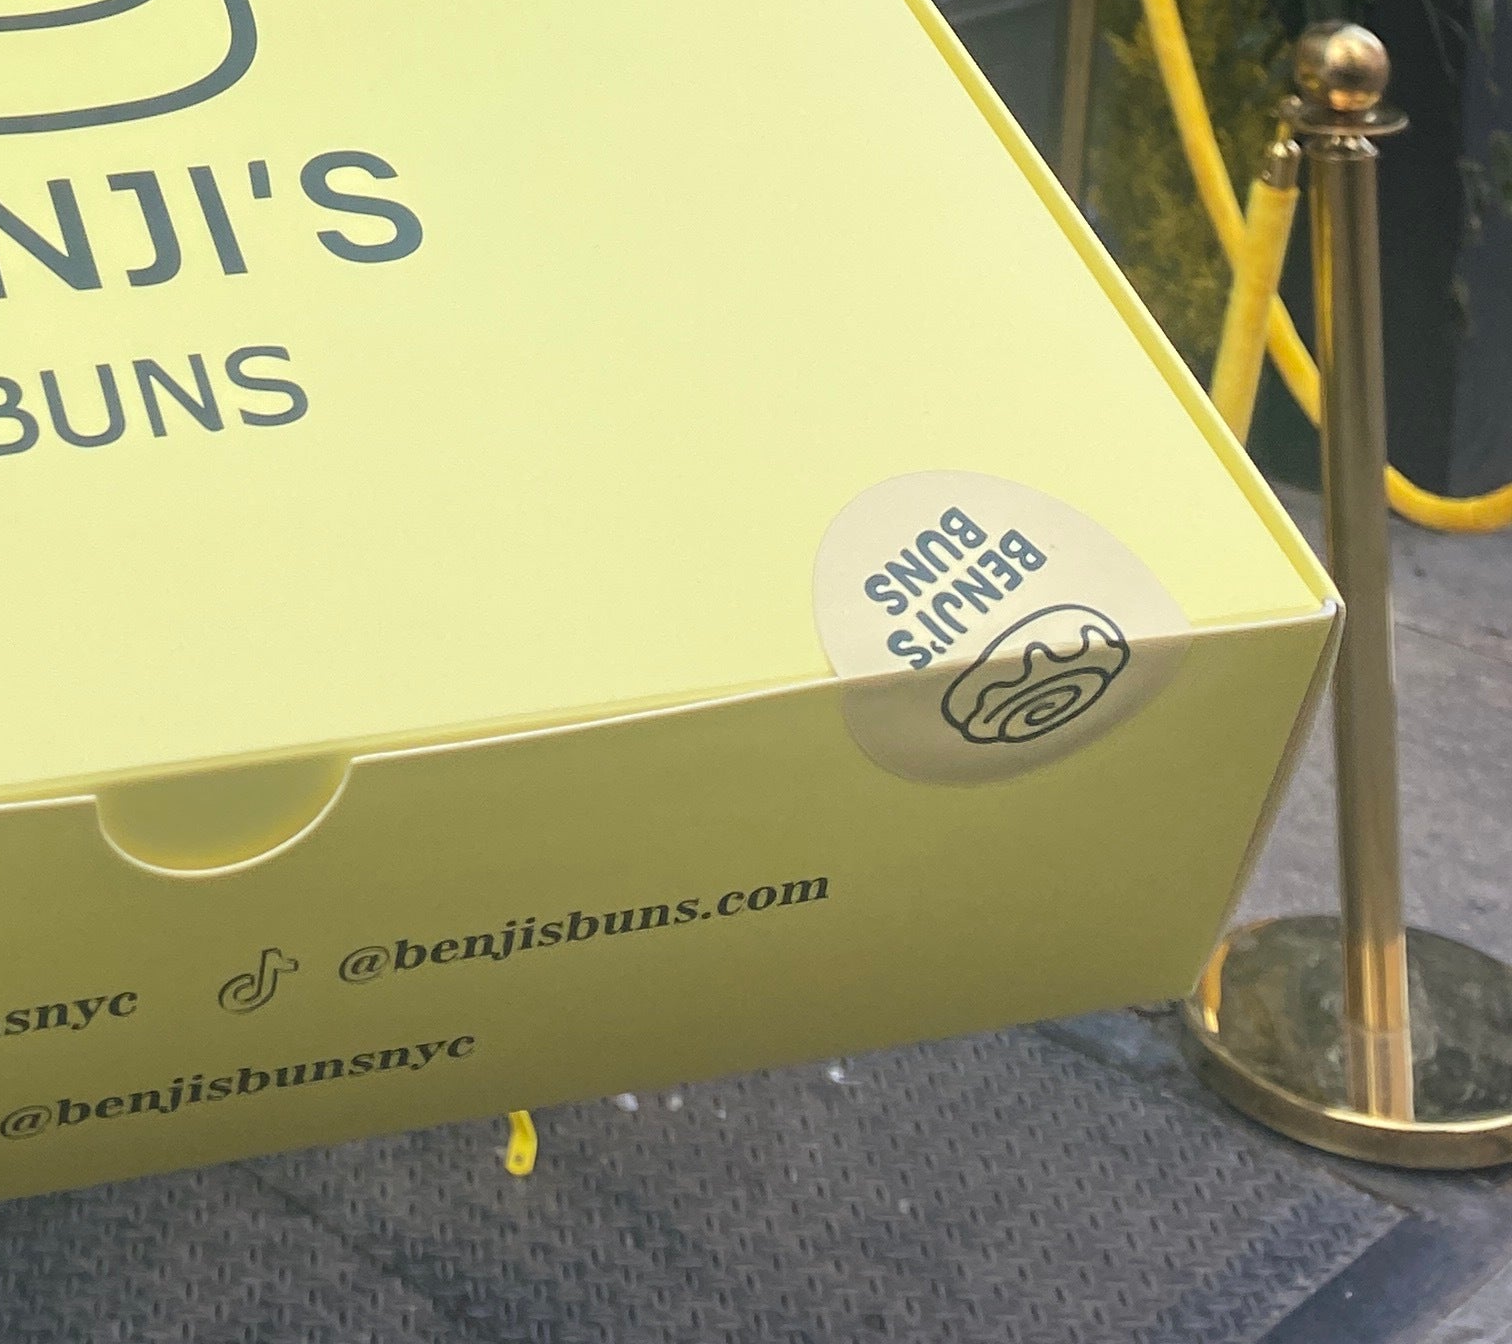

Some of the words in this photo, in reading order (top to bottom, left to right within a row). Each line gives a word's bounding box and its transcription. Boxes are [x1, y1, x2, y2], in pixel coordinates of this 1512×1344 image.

[864, 506, 988, 616] BUNS
[887, 528, 1048, 670] BENJI'S
[338, 874, 830, 984] @benjisbuns.com
[0, 1030, 476, 1140] @benjisbunsnyc
